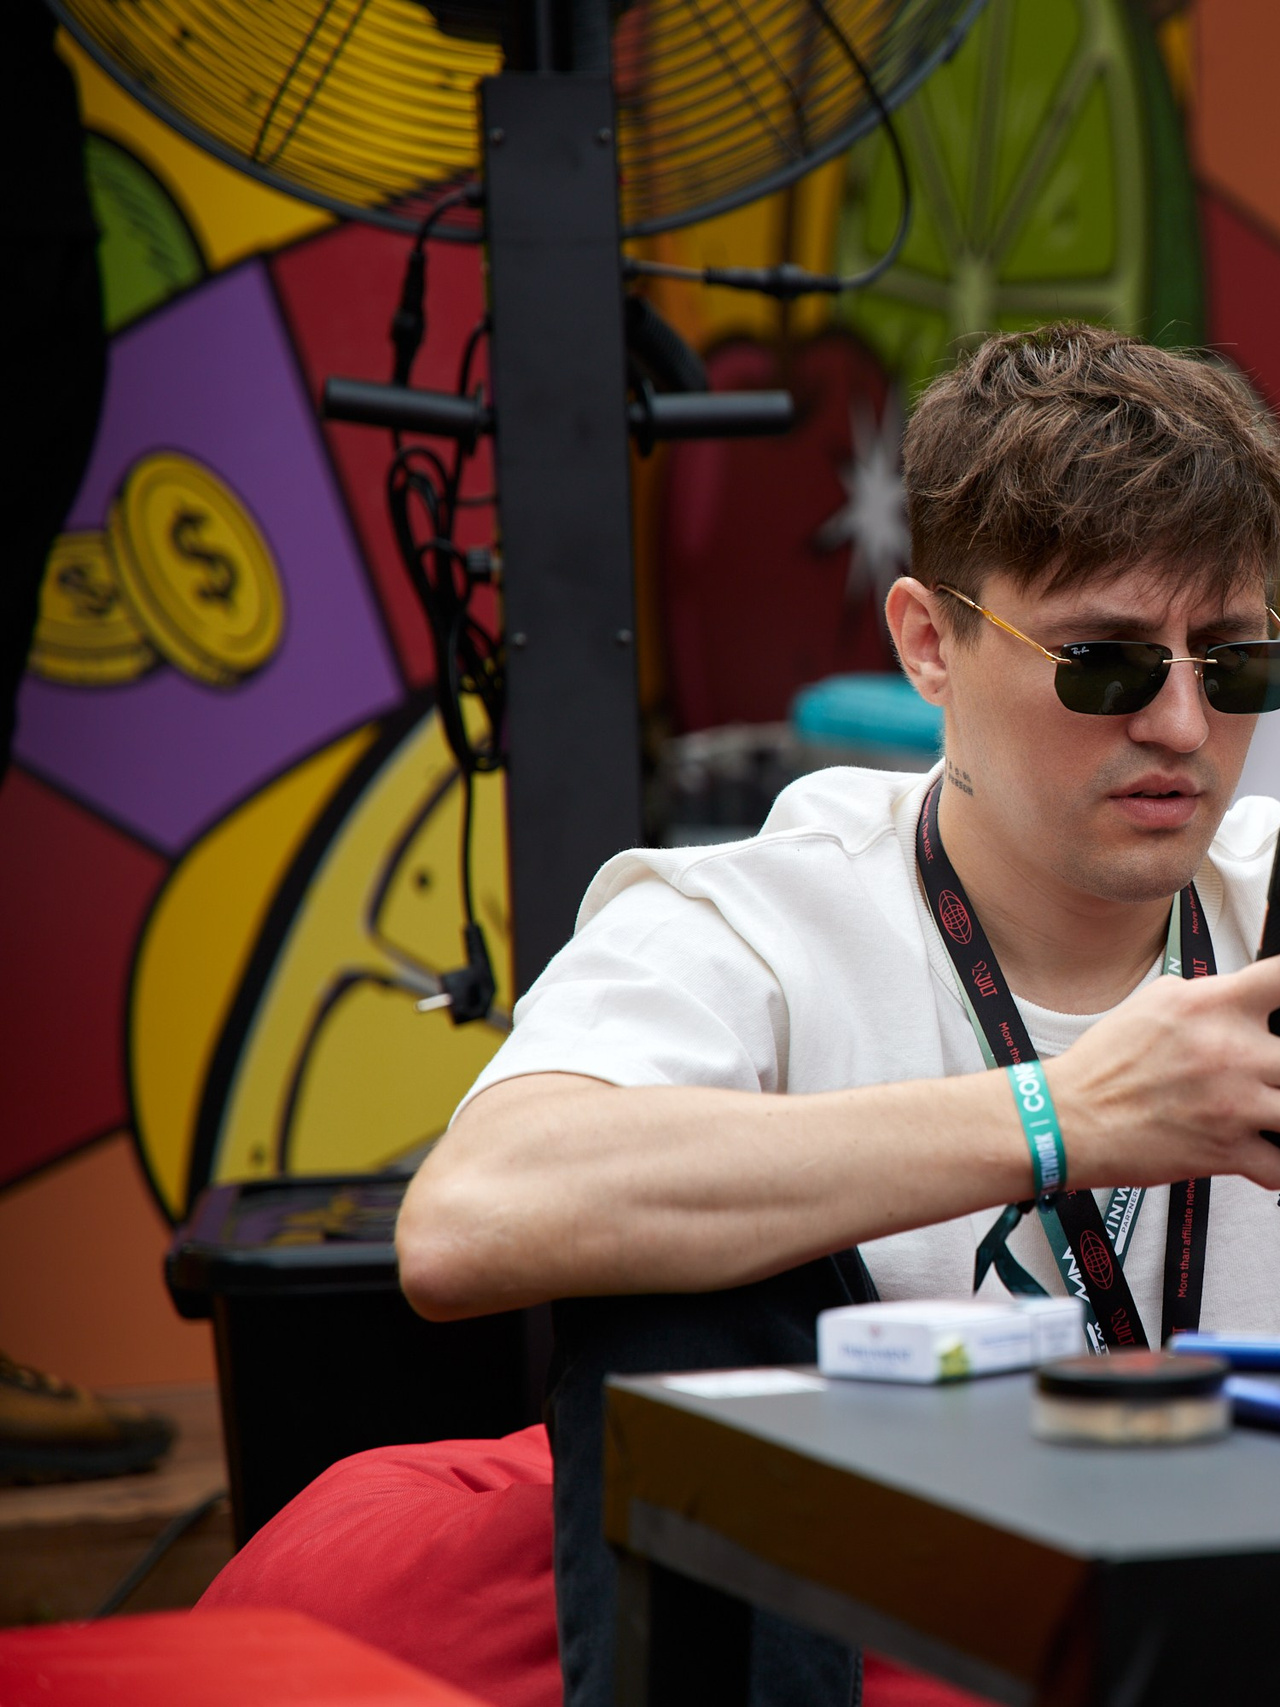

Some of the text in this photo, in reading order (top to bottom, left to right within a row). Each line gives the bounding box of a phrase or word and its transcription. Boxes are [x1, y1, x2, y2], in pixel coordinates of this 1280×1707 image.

[1193, 958, 1208, 979] ULT
[998, 1021, 1021, 1065] More tha
[1177, 1176, 1196, 1299] More than affiliate netwo
